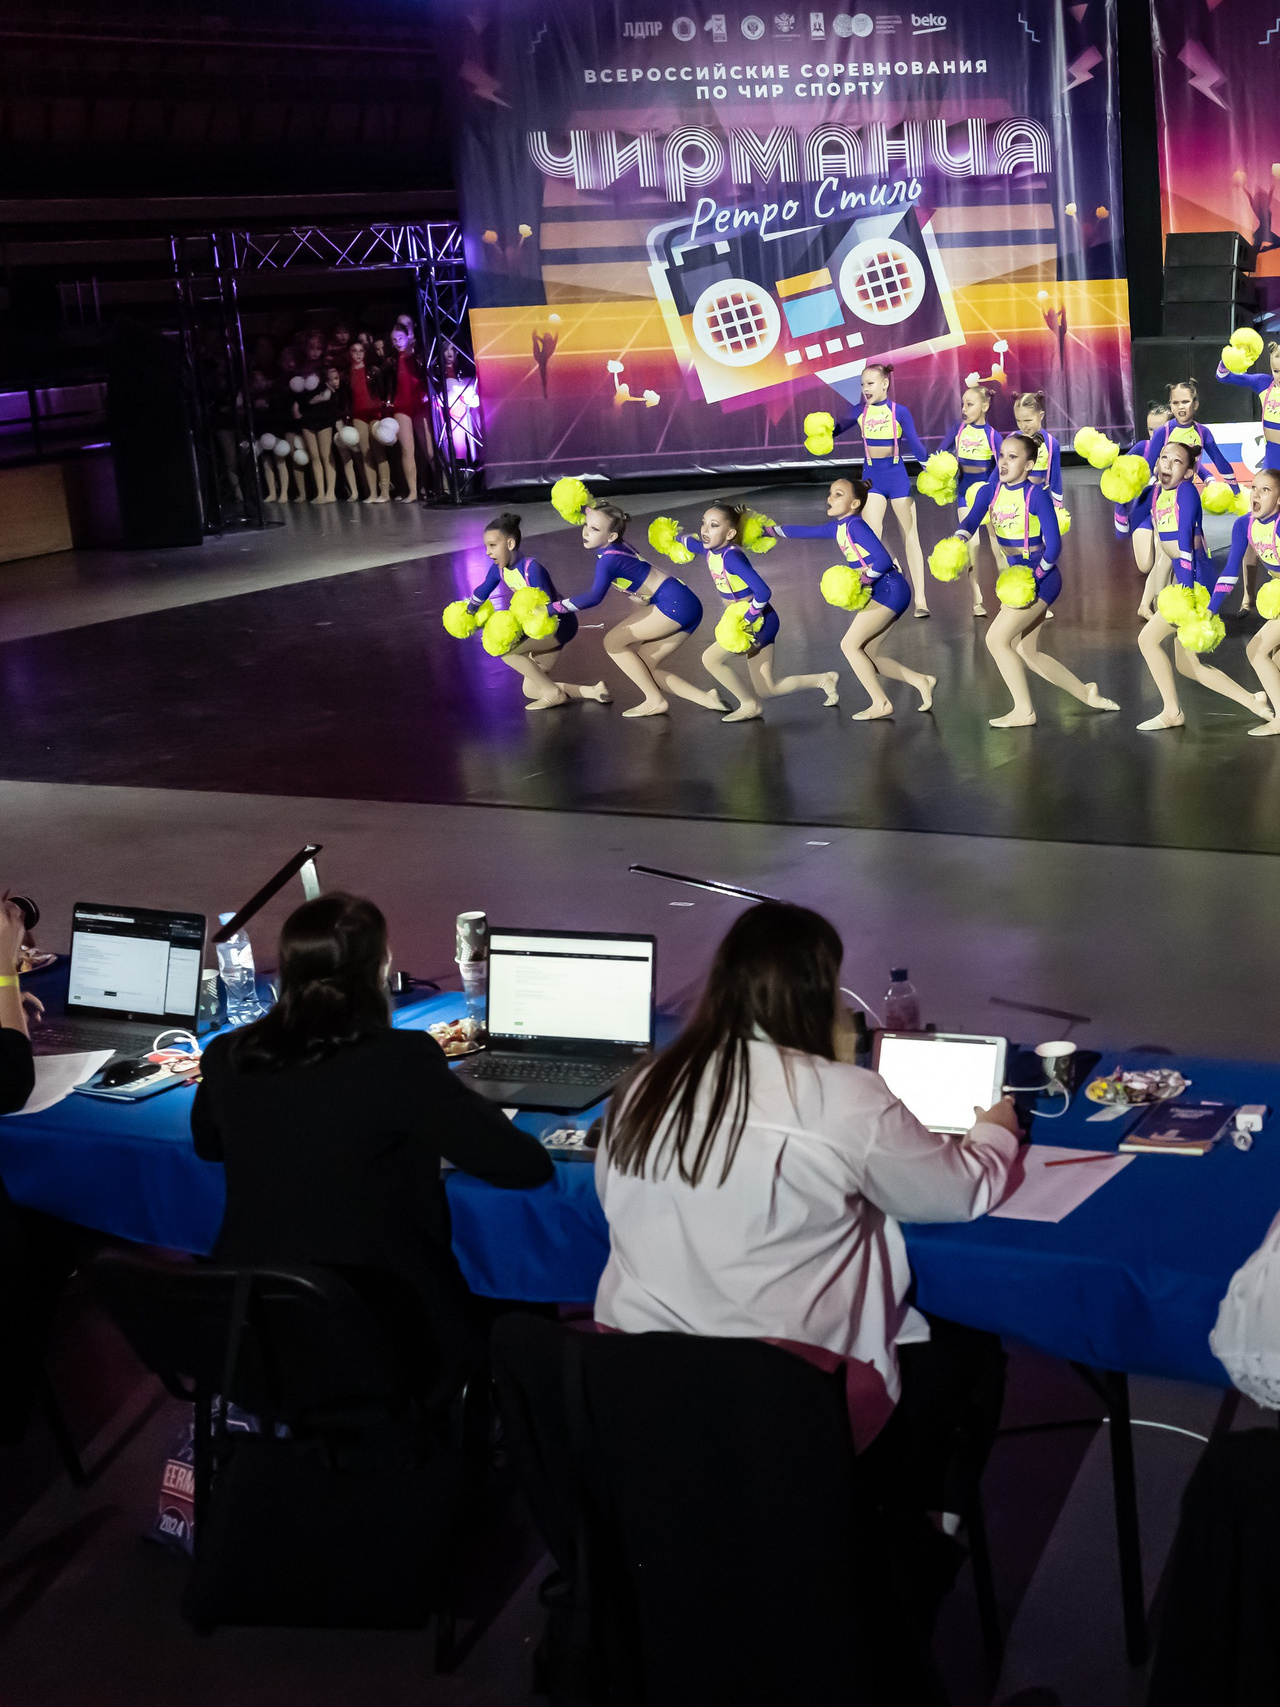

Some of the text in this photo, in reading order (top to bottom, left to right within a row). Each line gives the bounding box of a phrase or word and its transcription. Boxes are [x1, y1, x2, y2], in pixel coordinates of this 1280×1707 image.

[911, 13, 947, 27] beko
[623, 21, 663, 39] ЛДПР
[584, 59, 988, 84] ВСЕРОССИЙСКИЕ СОРЕВНОВАНИЯ
[696, 81, 885, 99] ПО ЧИР СПОРТУ
[690, 176, 923, 241] Ретро Стиль
